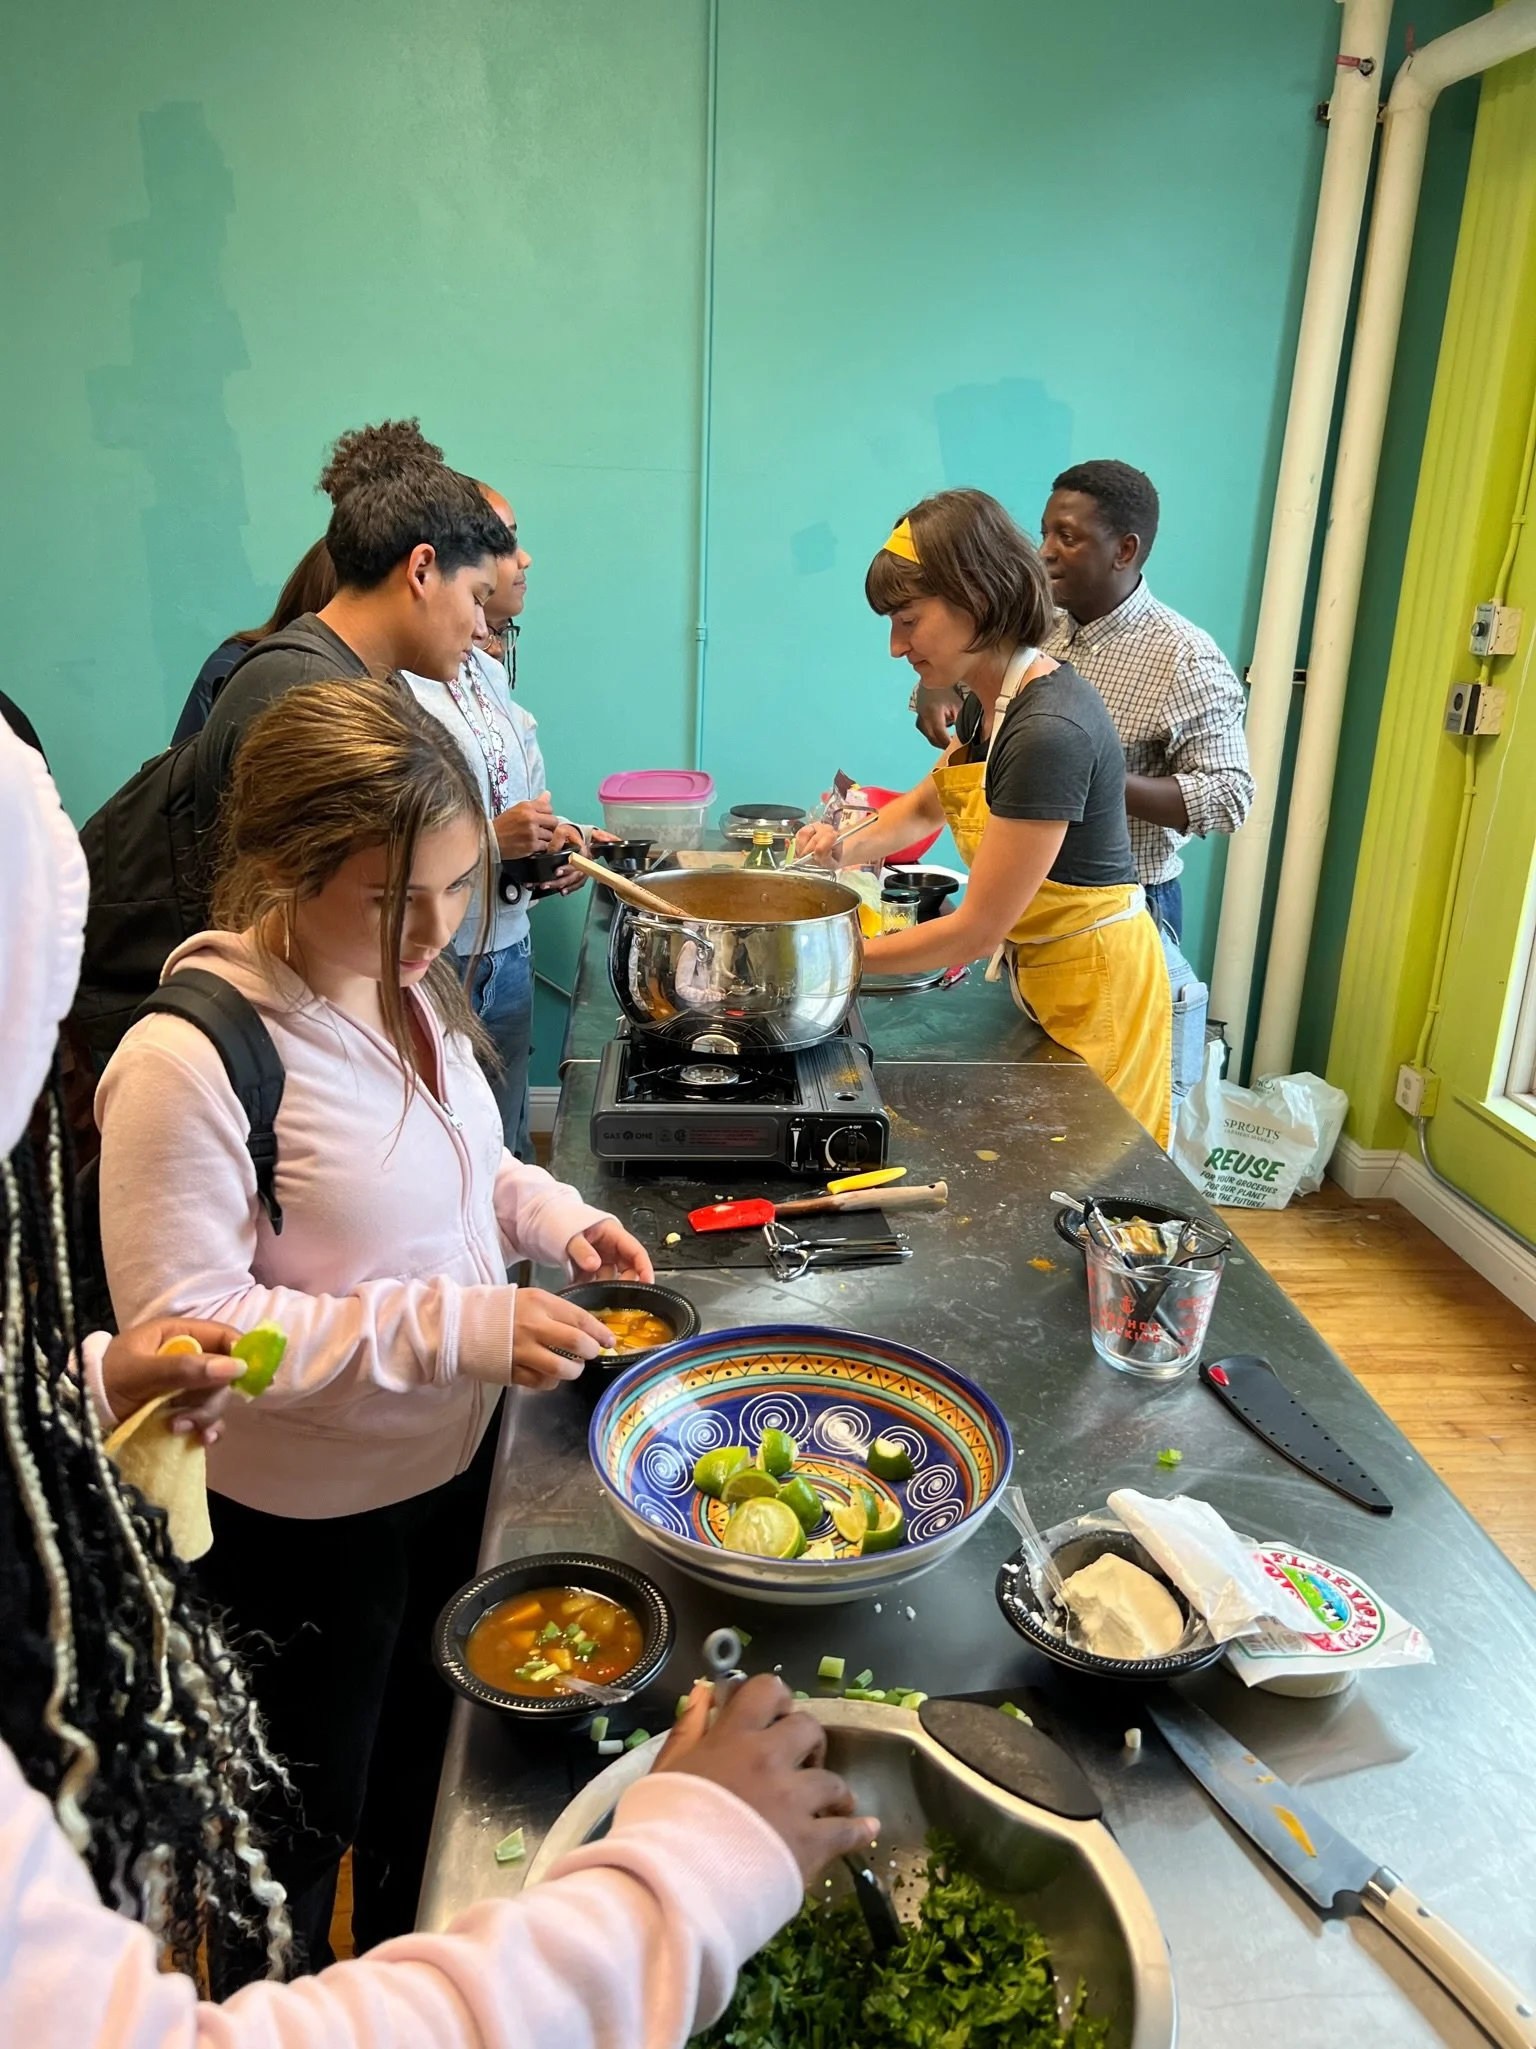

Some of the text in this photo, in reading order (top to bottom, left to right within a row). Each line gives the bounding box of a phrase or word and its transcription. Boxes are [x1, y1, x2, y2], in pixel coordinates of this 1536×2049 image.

[602, 1132, 621, 1140] GAS
[635, 1132, 654, 1140] ONE
[1223, 1118, 1281, 1141] SPROUTS
[1203, 1146, 1286, 1182] REUSE
[1200, 1170, 1278, 1195] FOR YOUR GROCERIES
[1204, 1181, 1268, 1201] FOR OUR PLANET
[1201, 1189, 1267, 1209] FOR THE FUTURE!
